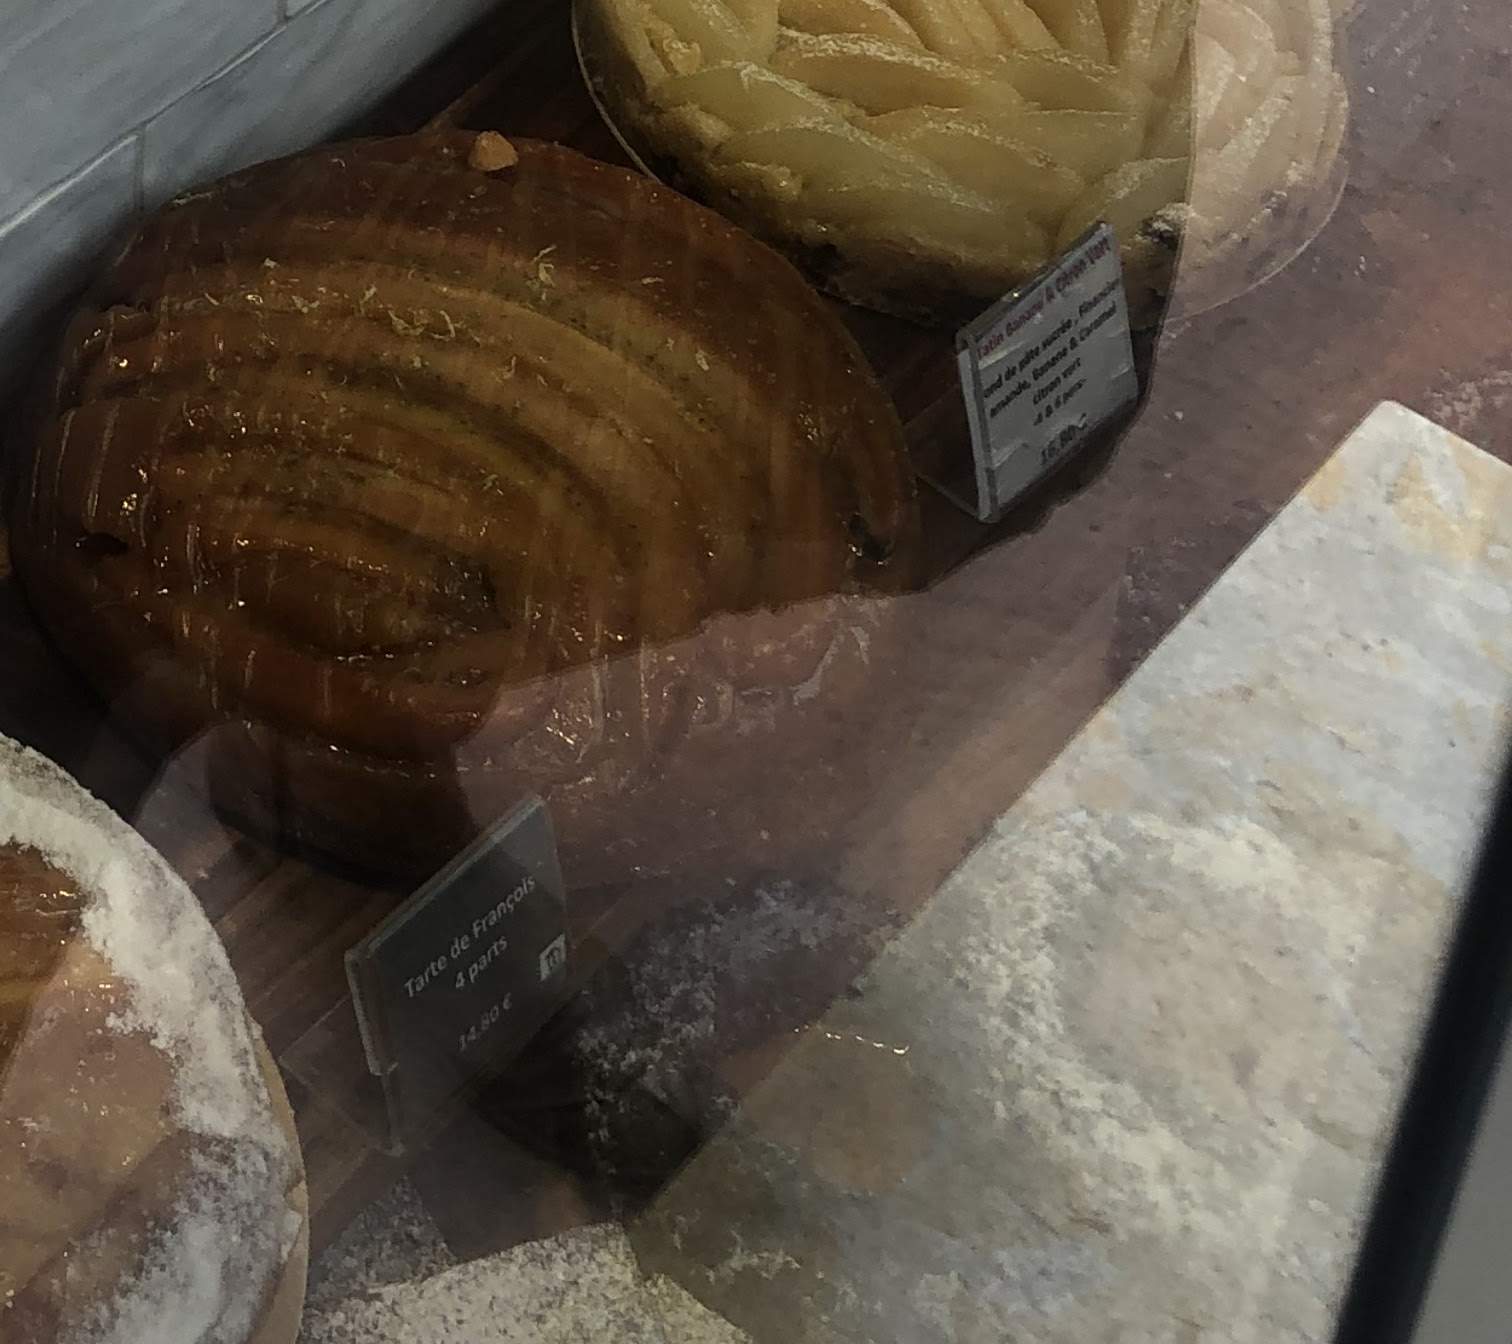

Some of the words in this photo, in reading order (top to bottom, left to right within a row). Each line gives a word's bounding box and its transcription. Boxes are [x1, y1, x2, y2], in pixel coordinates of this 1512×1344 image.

[1005, 365, 1016, 381] de
[1032, 375, 1061, 405] citron
[404, 955, 447, 997] Tarte
[450, 934, 470, 958] de
[472, 875, 535, 938] François
[455, 971, 465, 989] 4
[469, 936, 508, 983] parts
[503, 992, 513, 1010] €
